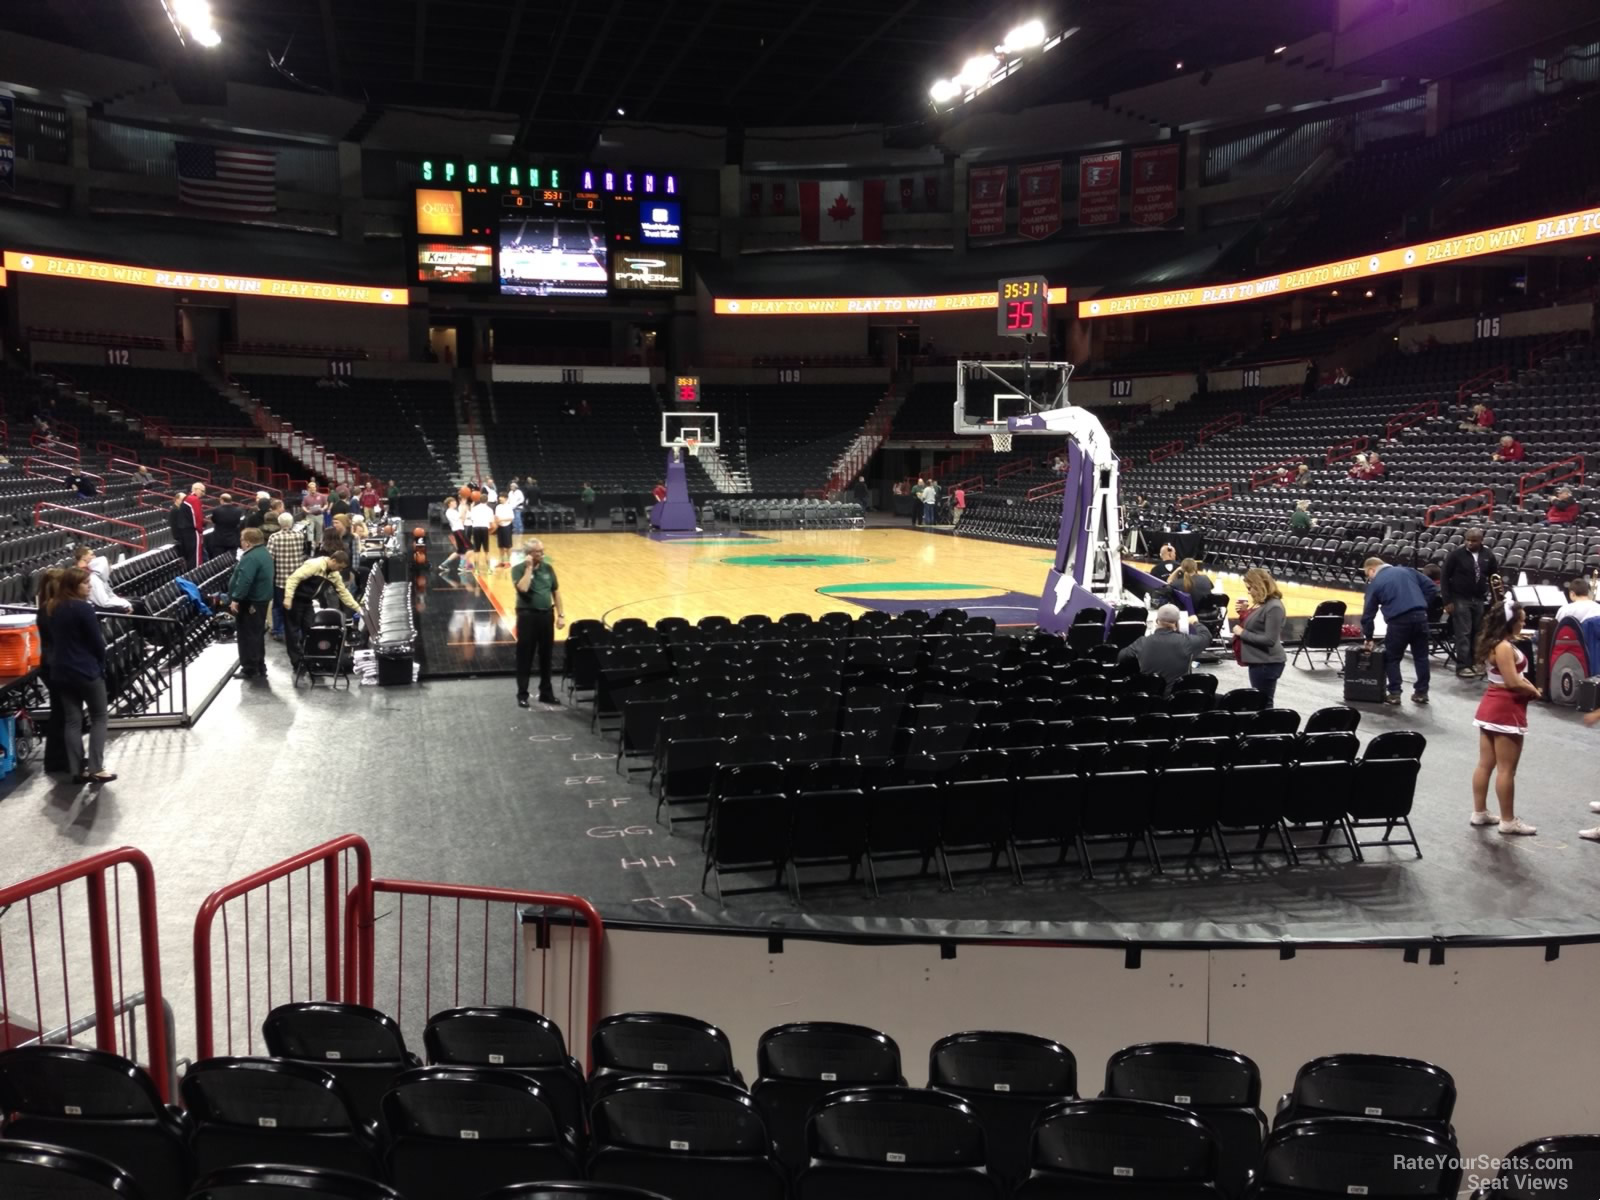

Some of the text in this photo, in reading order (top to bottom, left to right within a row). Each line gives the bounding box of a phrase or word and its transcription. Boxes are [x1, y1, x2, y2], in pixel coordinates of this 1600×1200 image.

[423, 161, 675, 194] SPOKANE ARENA
[1425, 240, 1463, 261] PLAY
[1464, 236, 1484, 253] TO
[1488, 226, 1527, 249] WIN!
[1535, 215, 1580, 240] PLAY
[47, 259, 370, 300] PLAY TO WIN! PLAY TO WIN! PLAY TO WIN!
[1109, 261, 1361, 313] PLAY TO WIN! PLAY TO WIN! PLAY TO WIN!
[1004, 282, 1038, 299] 35:31
[750, 294, 997, 312] PLAY TO WIN! PLAY TO WIN! PLAY TO
[1007, 301, 1033, 329] 35
[1477, 318, 1500, 339] 105
[108, 349, 129, 365] 112
[331, 361, 351, 376] 111
[779, 369, 800, 383] 109
[1112, 381, 1131, 395] 107
[586, 797, 632, 809] FF
[586, 825, 653, 839] GG
[621, 855, 676, 870] HH
